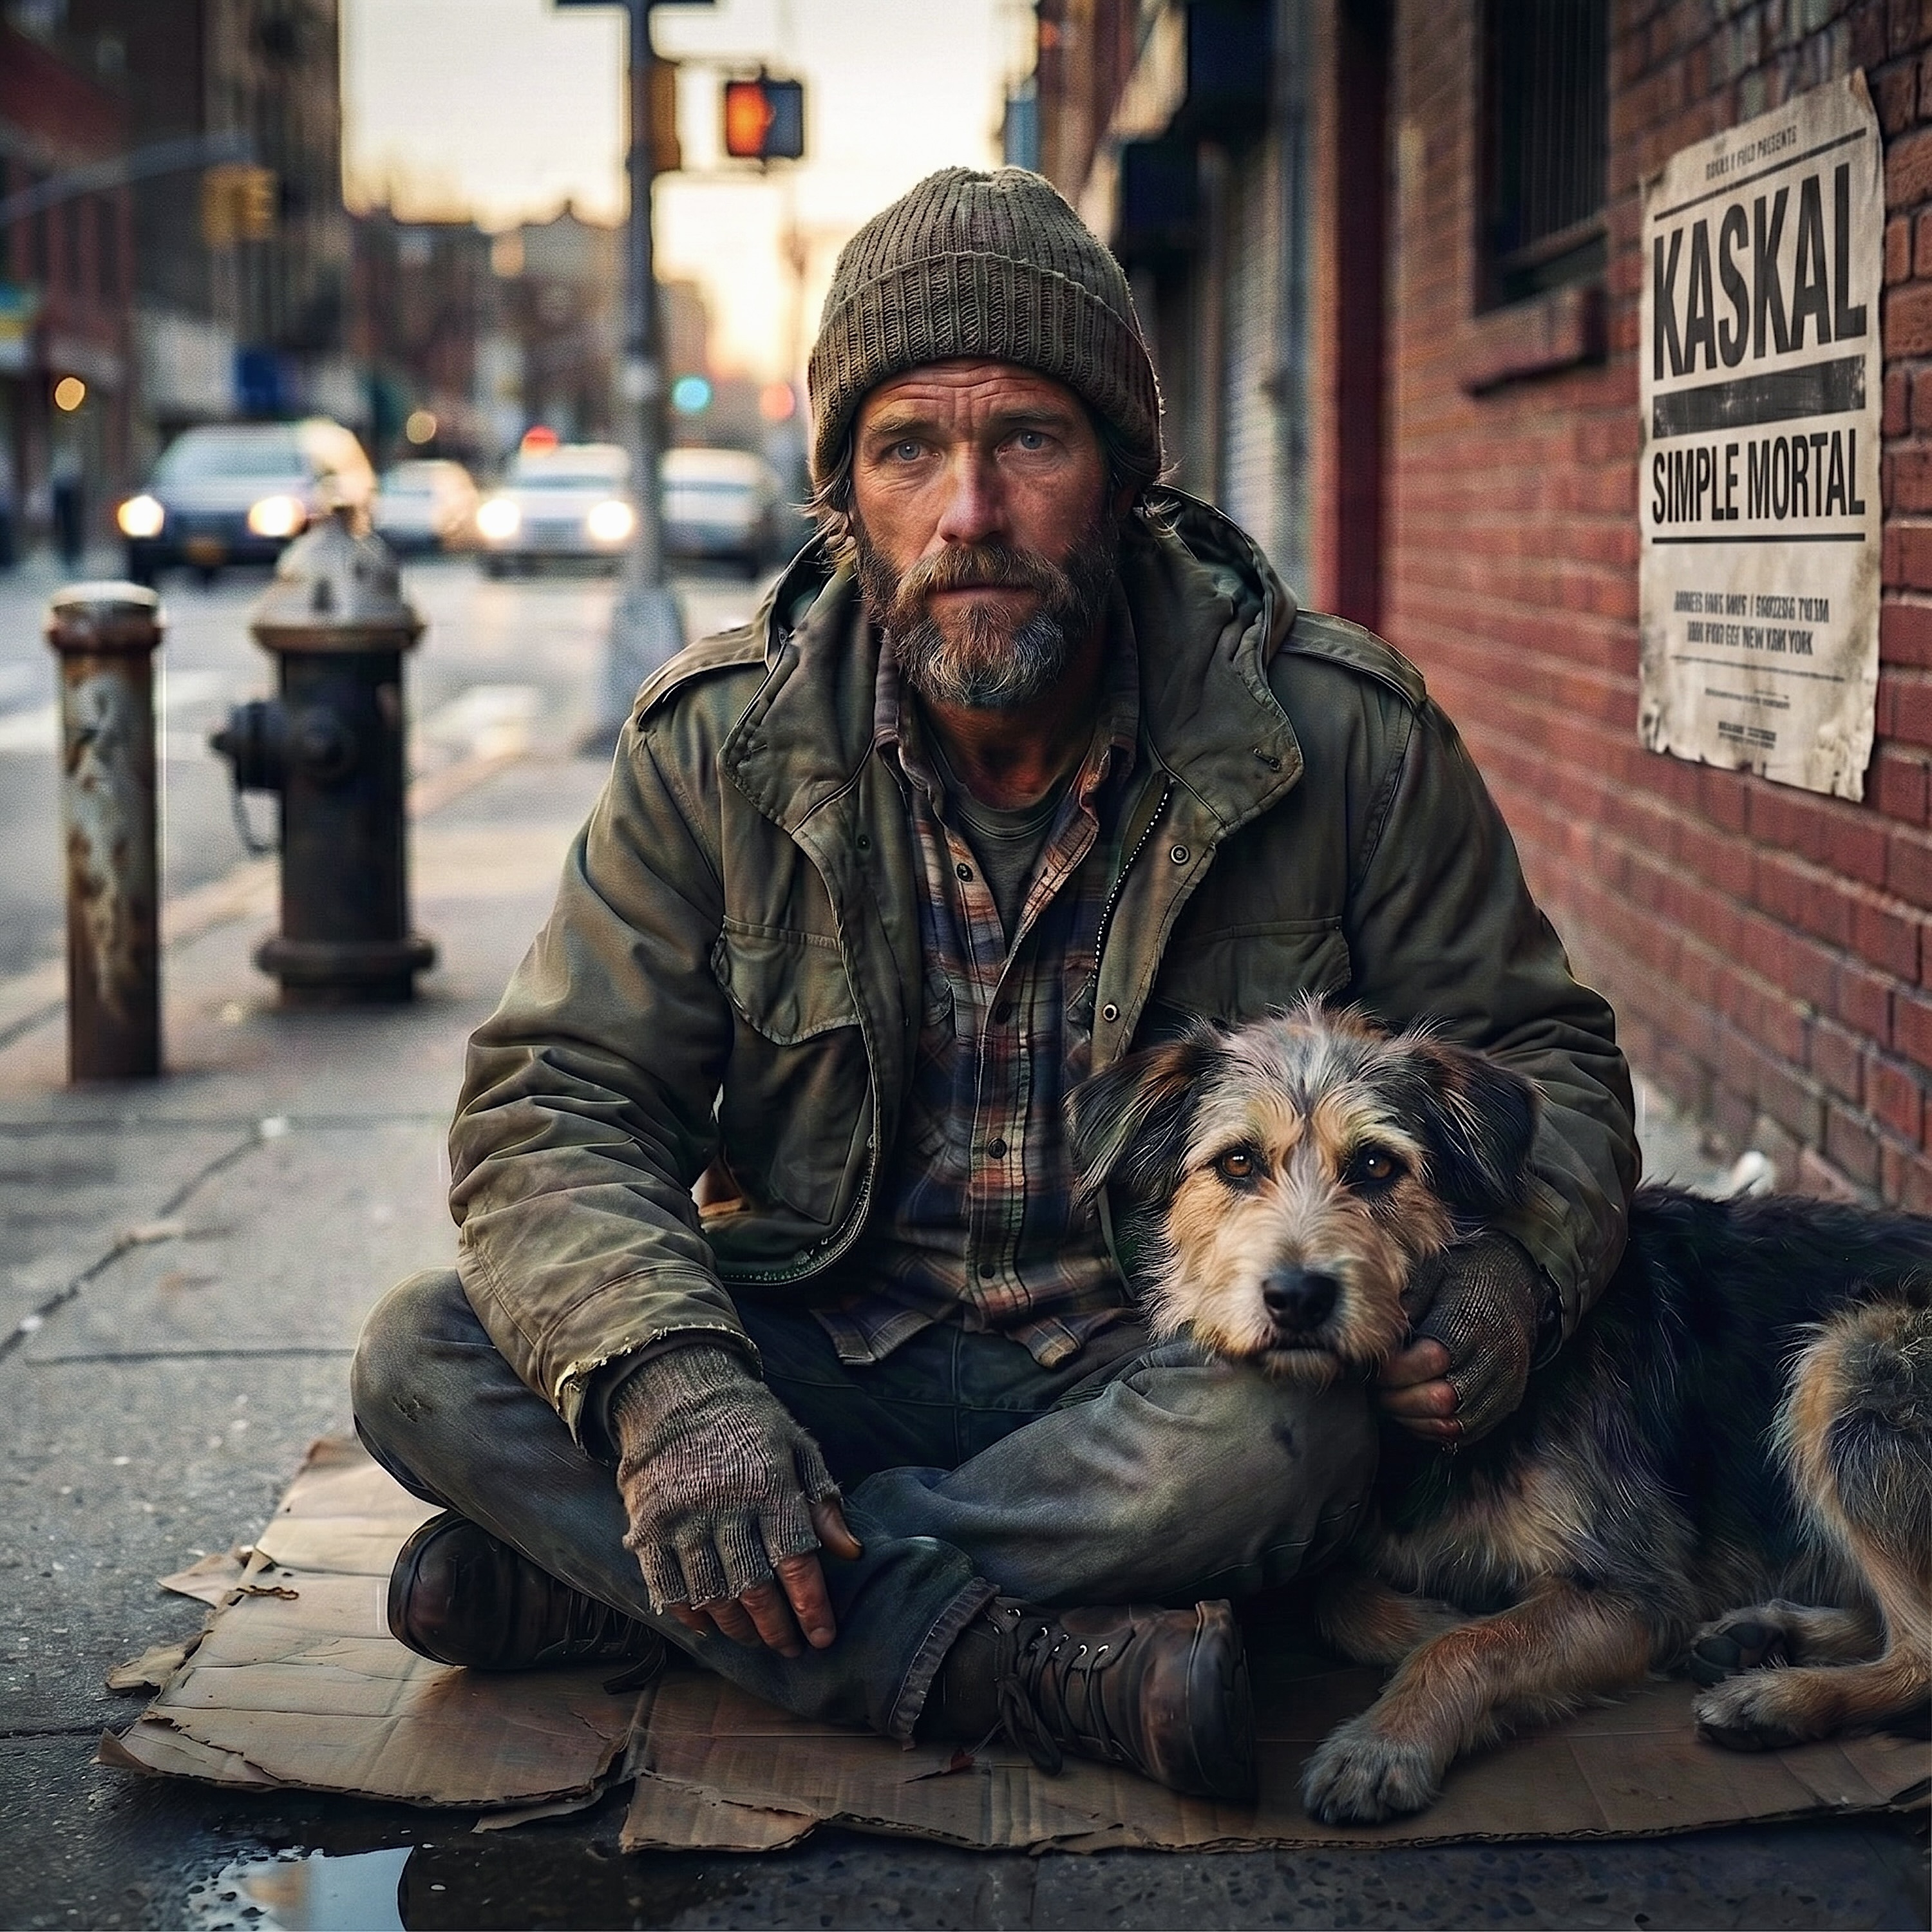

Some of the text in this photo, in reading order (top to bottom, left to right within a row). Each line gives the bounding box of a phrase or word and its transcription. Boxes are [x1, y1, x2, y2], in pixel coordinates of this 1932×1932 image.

[1654, 163, 1866, 381] KASKAL
[1653, 428, 1866, 524] SIMPLE MORTAL
[1743, 625, 1763, 650] NEW
